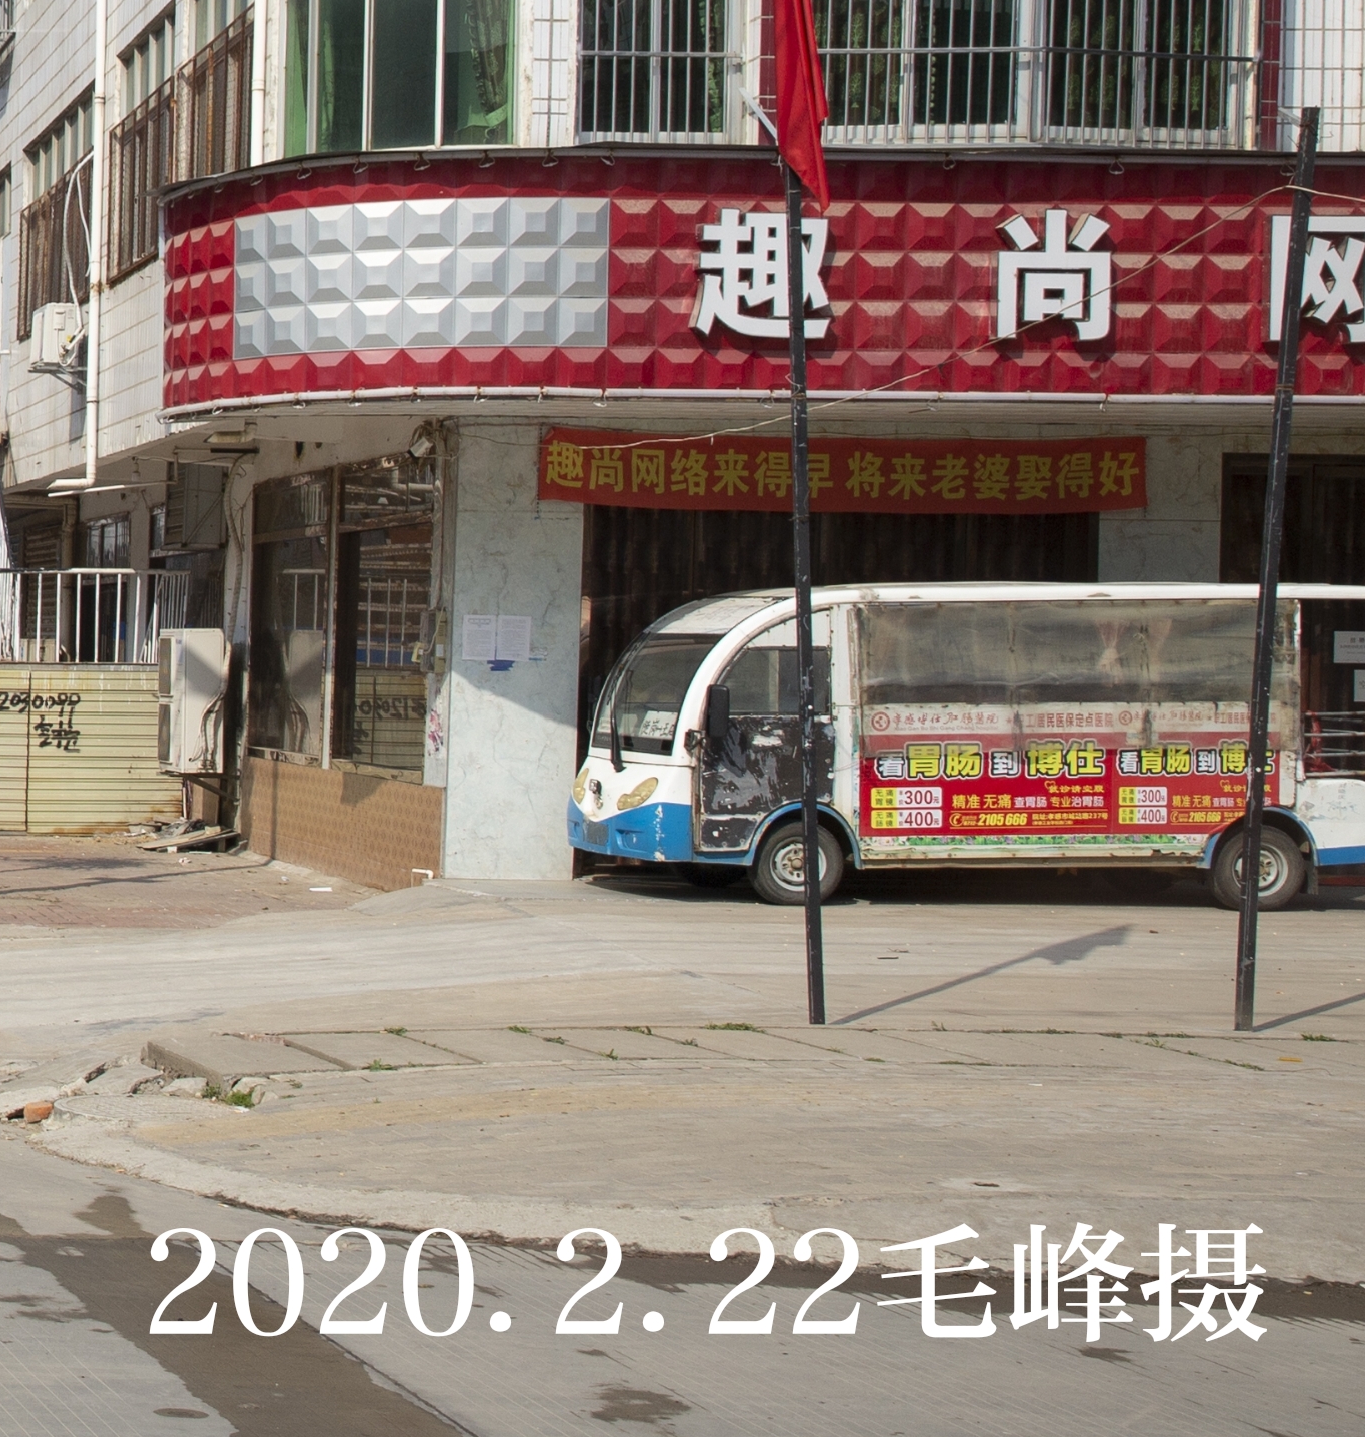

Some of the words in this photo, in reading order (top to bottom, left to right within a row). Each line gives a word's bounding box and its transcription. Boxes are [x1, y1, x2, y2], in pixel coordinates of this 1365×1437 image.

[544, 439, 832, 498] 趣尚网络来得早
[846, 450, 1140, 500] 将来老婆娶得好
[1017, 712, 1115, 728] 工居民医保定点医院
